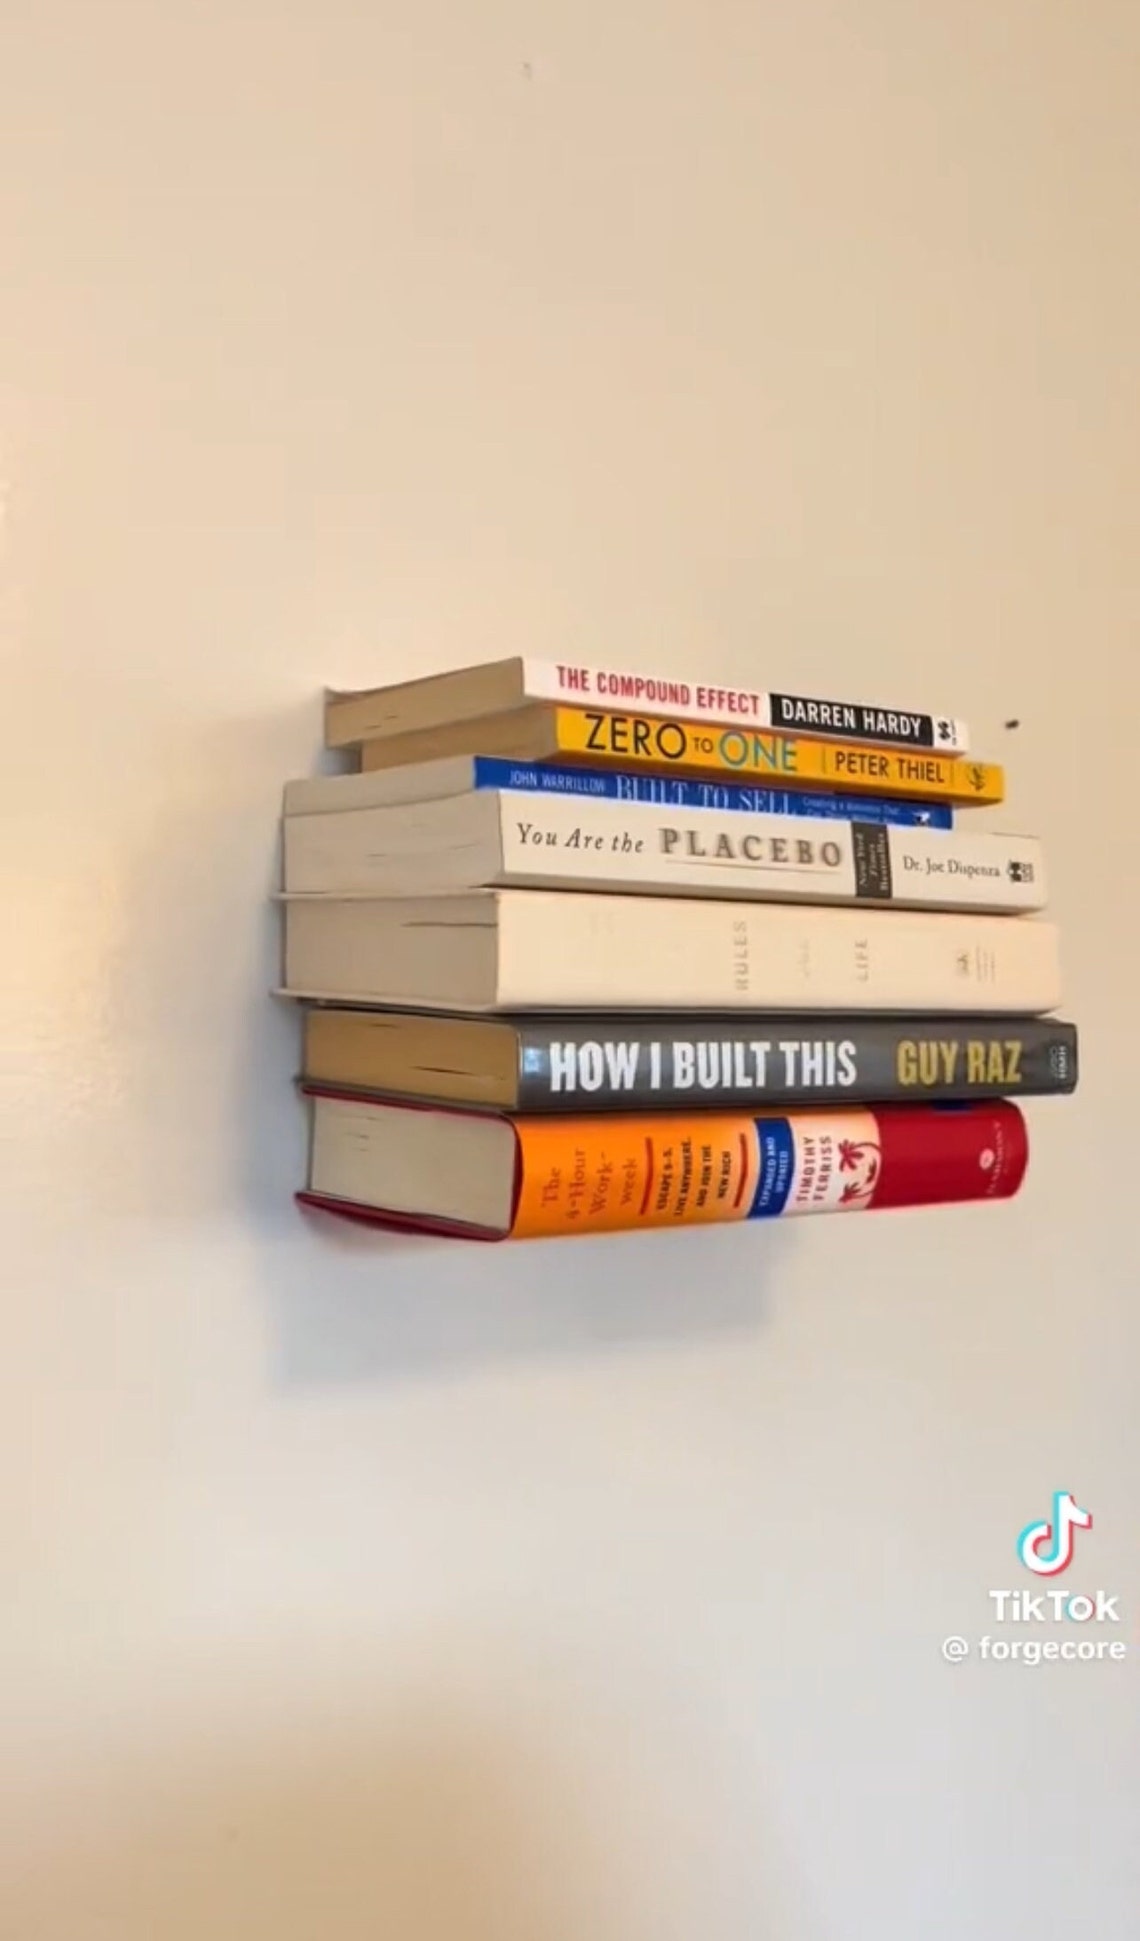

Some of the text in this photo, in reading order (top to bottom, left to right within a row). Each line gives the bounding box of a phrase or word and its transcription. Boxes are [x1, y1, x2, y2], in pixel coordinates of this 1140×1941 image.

[556, 665, 760, 716] THE COMPOUND EFFECT
[780, 698, 855, 729] DARREN
[863, 708, 922, 738] HARDY
[585, 713, 798, 771] ZERO TO ONE
[509, 770, 537, 787] JOHN
[835, 750, 945, 784] PETER THIEL
[616, 774, 688, 805] BUILT
[698, 784, 730, 809] TO
[517, 823, 844, 868] You Are the PLACEBO
[902, 855, 923, 871] Dr.
[926, 858, 945, 876] Joe
[734, 920, 748, 991] RULES
[855, 939, 868, 982] LIFE
[550, 1040, 857, 1092] HOW I BUILT THIS
[897, 1040, 1022, 1085] GUY RAZ
[701, 1144, 711, 1162] THE
[717, 1150, 731, 1199] NEW RICH
[795, 1136, 815, 1202] TIMOTHY
[812, 1135, 832, 1201] FERRISS
[541, 1167, 561, 1208] The
[566, 1148, 586, 1220] 4-Hour
[589, 1151, 613, 1215] Work-
[620, 1157, 638, 1206] week
